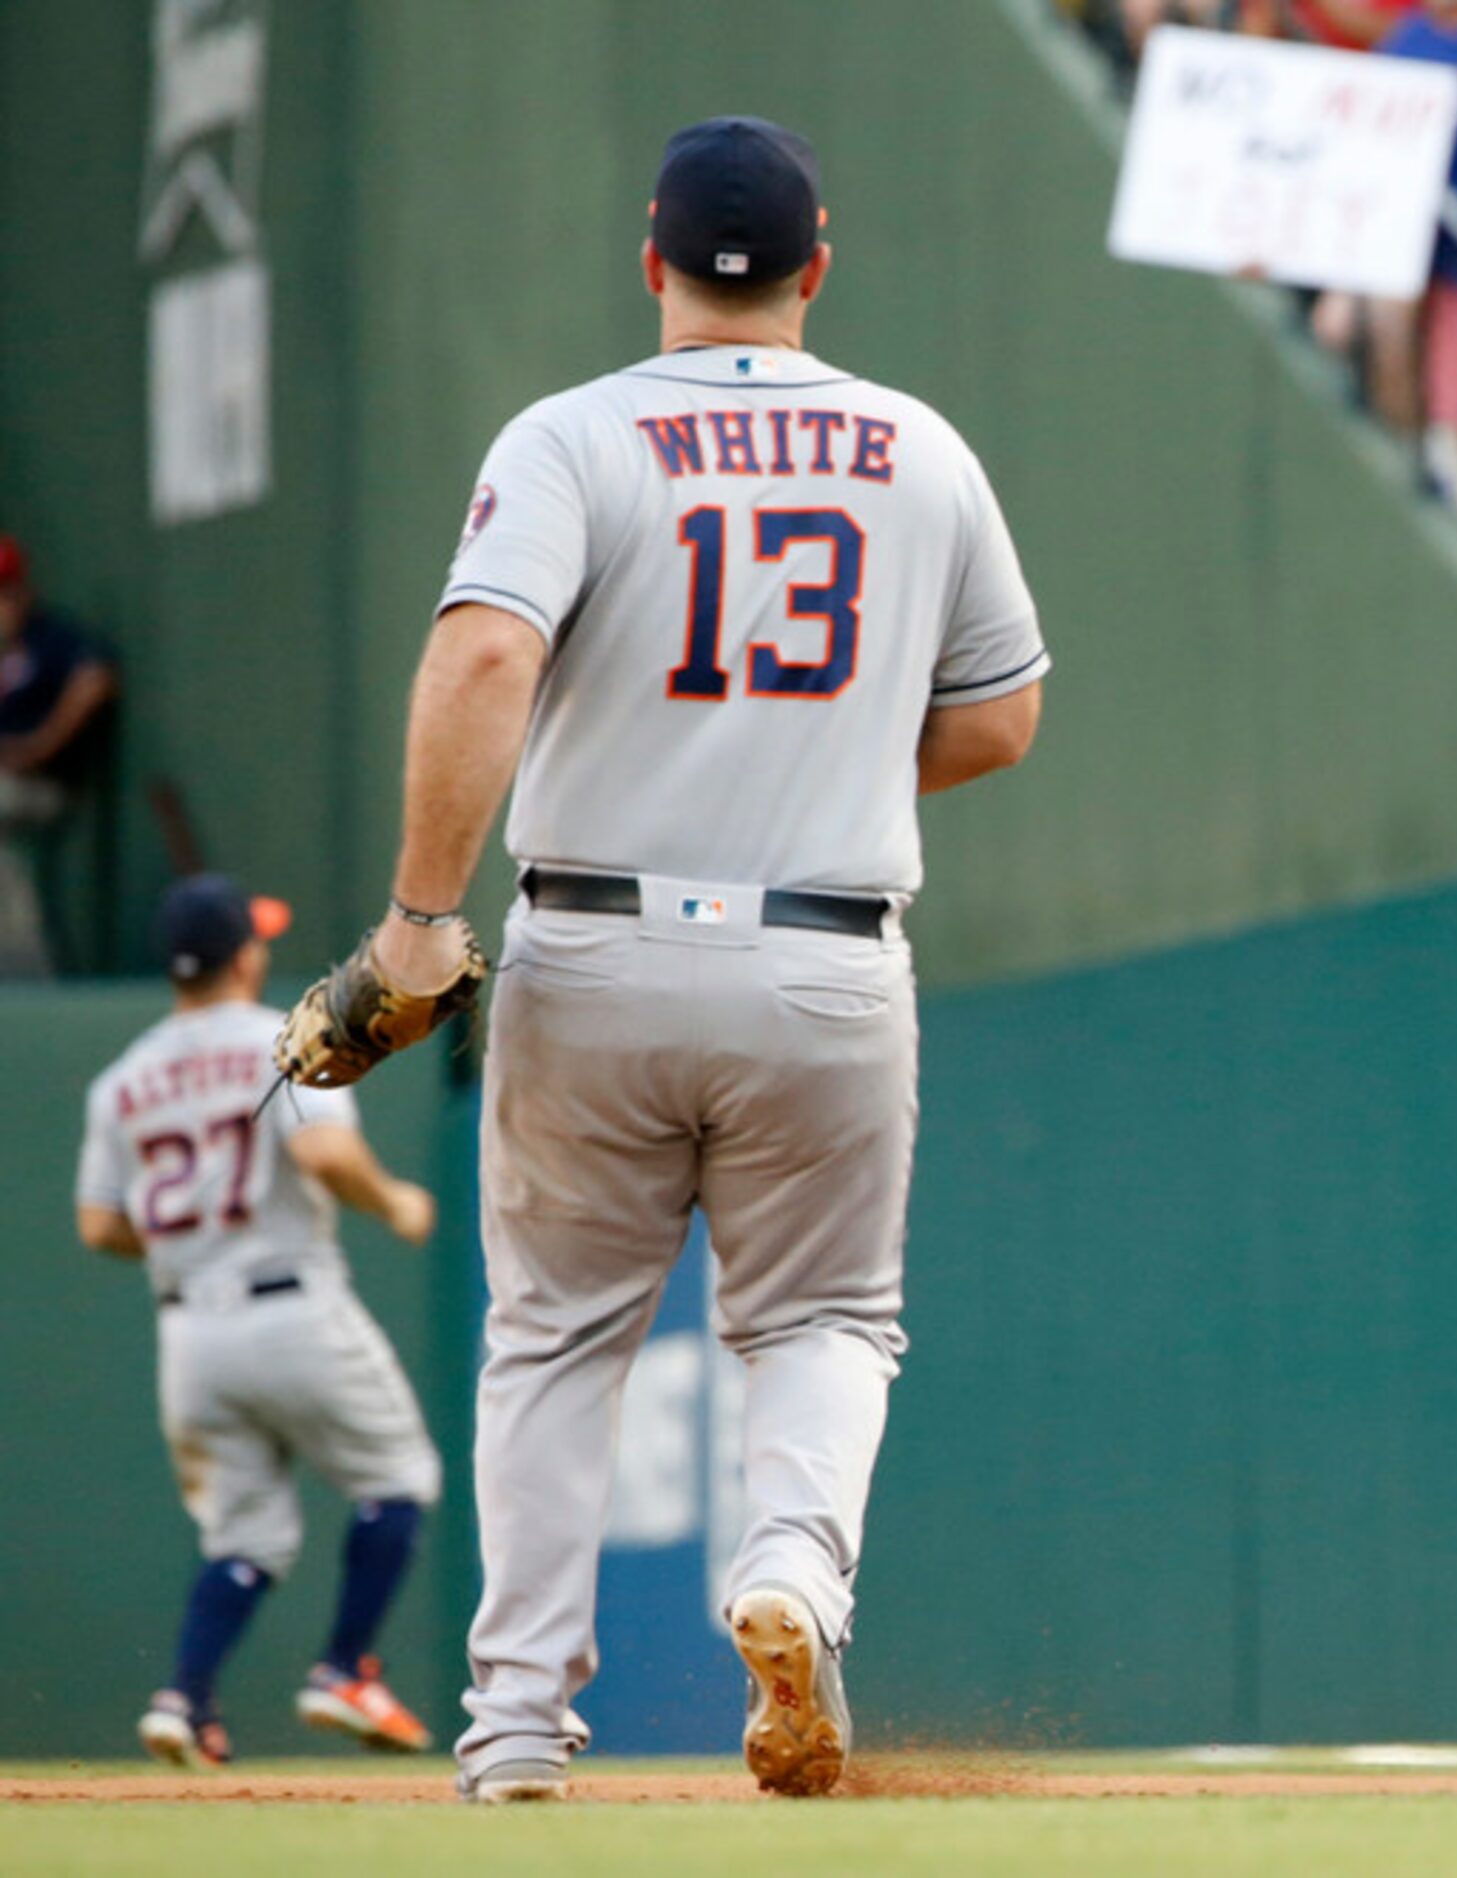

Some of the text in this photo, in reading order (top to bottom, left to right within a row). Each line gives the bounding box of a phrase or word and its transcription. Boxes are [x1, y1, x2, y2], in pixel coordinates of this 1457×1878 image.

[637, 408, 897, 486] WHITE
[666, 503, 866, 702] 13
[138, 1111, 254, 1236] 27
